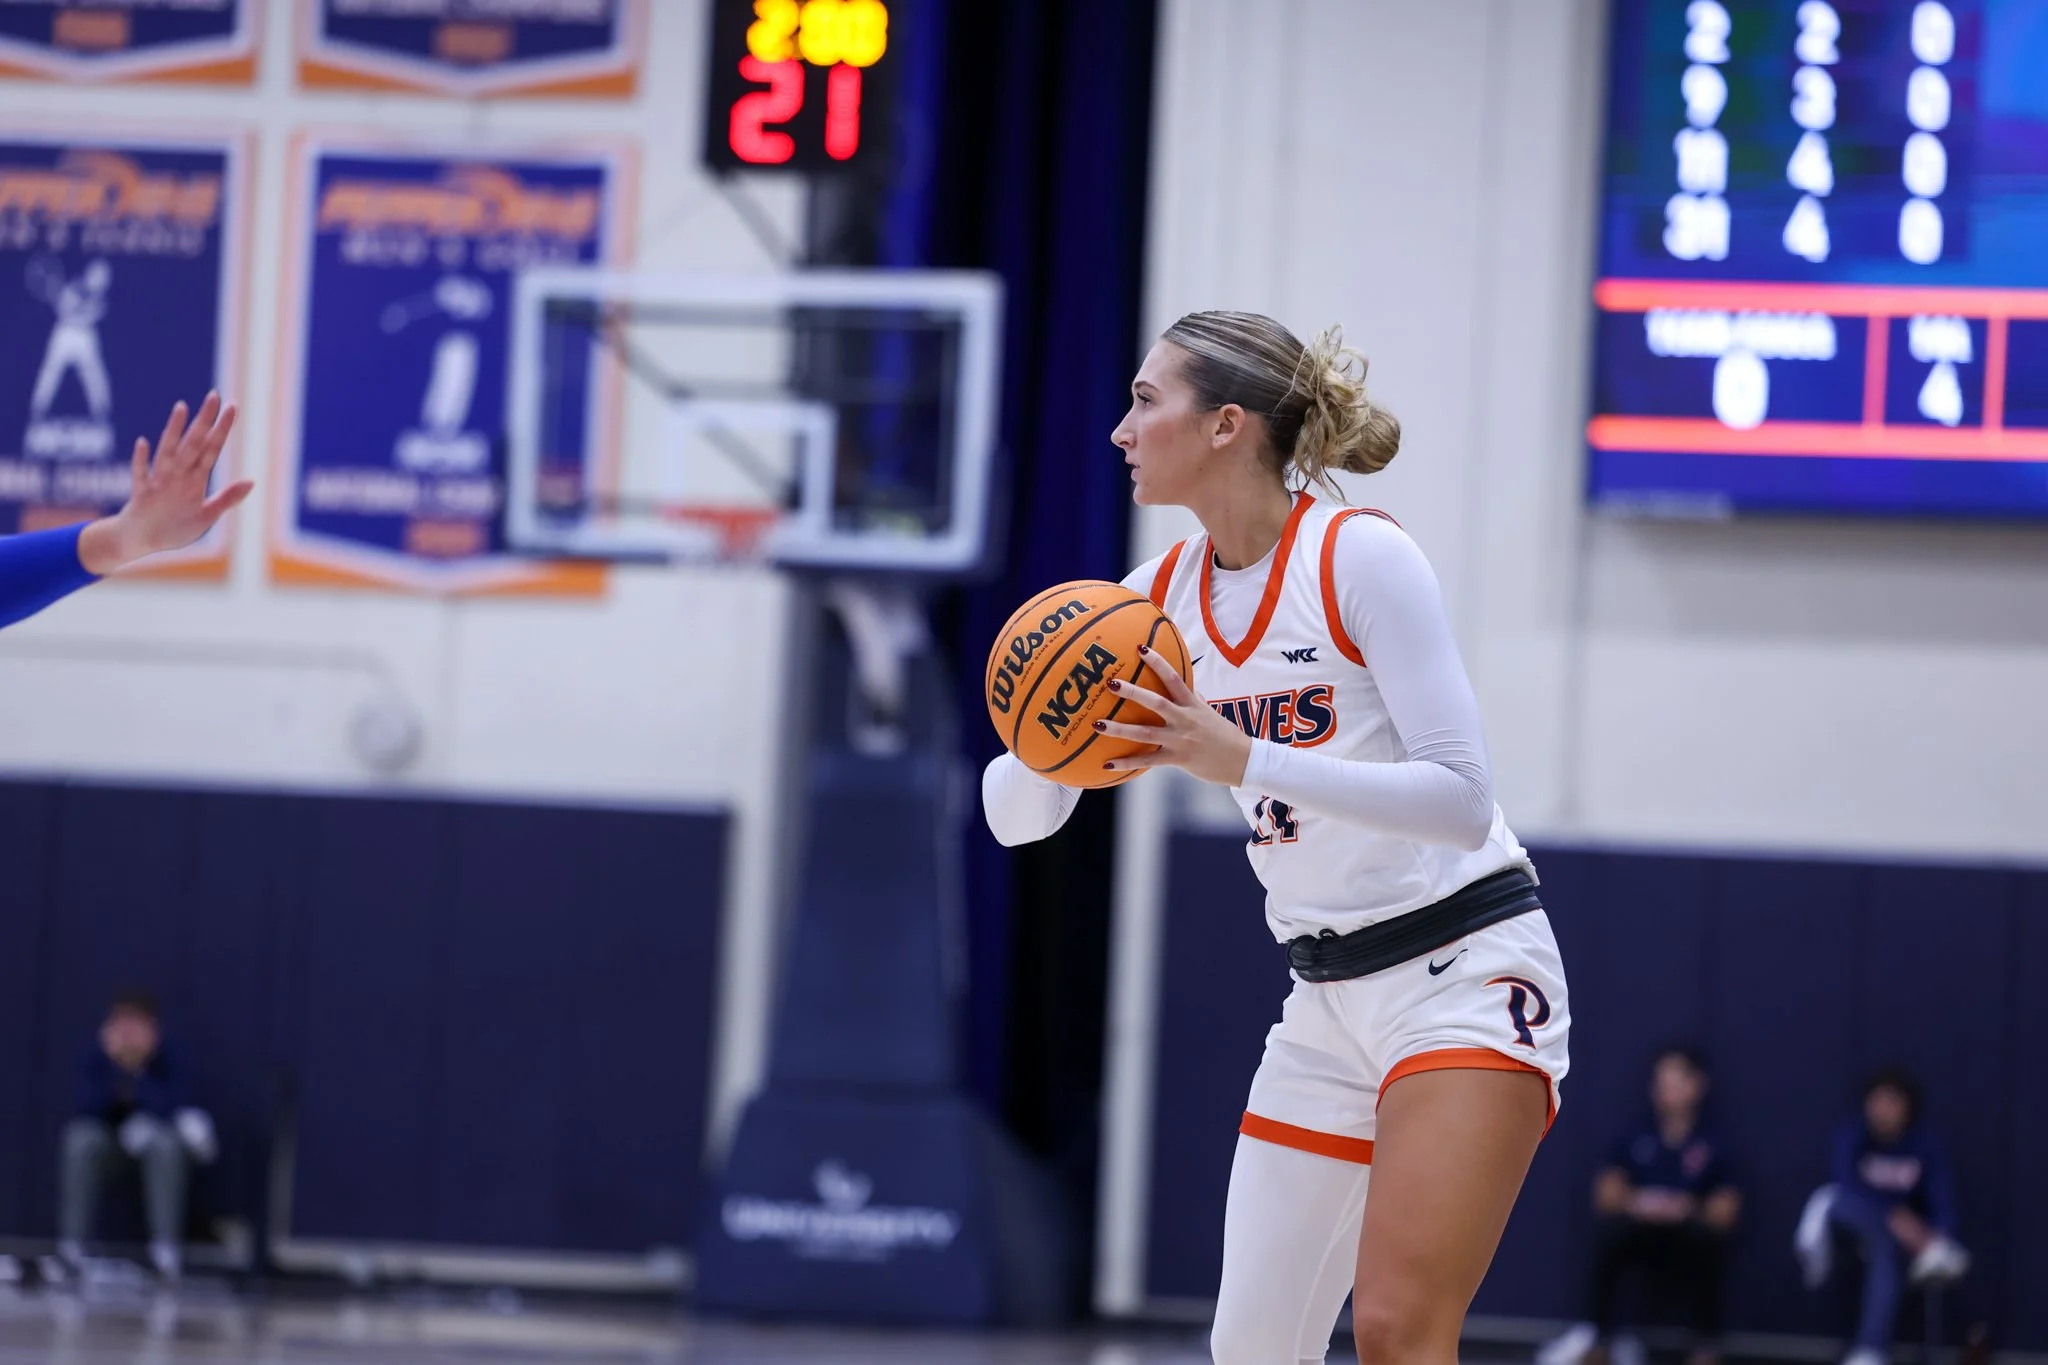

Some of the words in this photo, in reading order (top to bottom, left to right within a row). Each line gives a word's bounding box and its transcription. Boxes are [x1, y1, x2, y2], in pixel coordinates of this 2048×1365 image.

[1684, 0, 1731, 64] 2
[1795, 0, 1841, 65] 2
[1911, 0, 1955, 65] 0
[729, 54, 861, 164] 21
[1681, 63, 1728, 128] 9
[1791, 65, 1836, 130] 3
[1907, 66, 1951, 131] 0
[1787, 130, 1834, 197] 4
[1903, 132, 1947, 198] 0
[1663, 192, 1730, 261] 31
[1782, 195, 1830, 263] 4
[1899, 197, 1943, 265] 0
[1713, 350, 1769, 430] 0
[1918, 359, 1964, 427] 4
[992, 599, 1090, 714] Wilson
[1280, 647, 1319, 664] WCC
[1037, 642, 1118, 741] NCAA
[1086, 684, 1107, 711] GAME
[1207, 684, 1337, 749] AVES
[1483, 974, 1552, 1051] P
